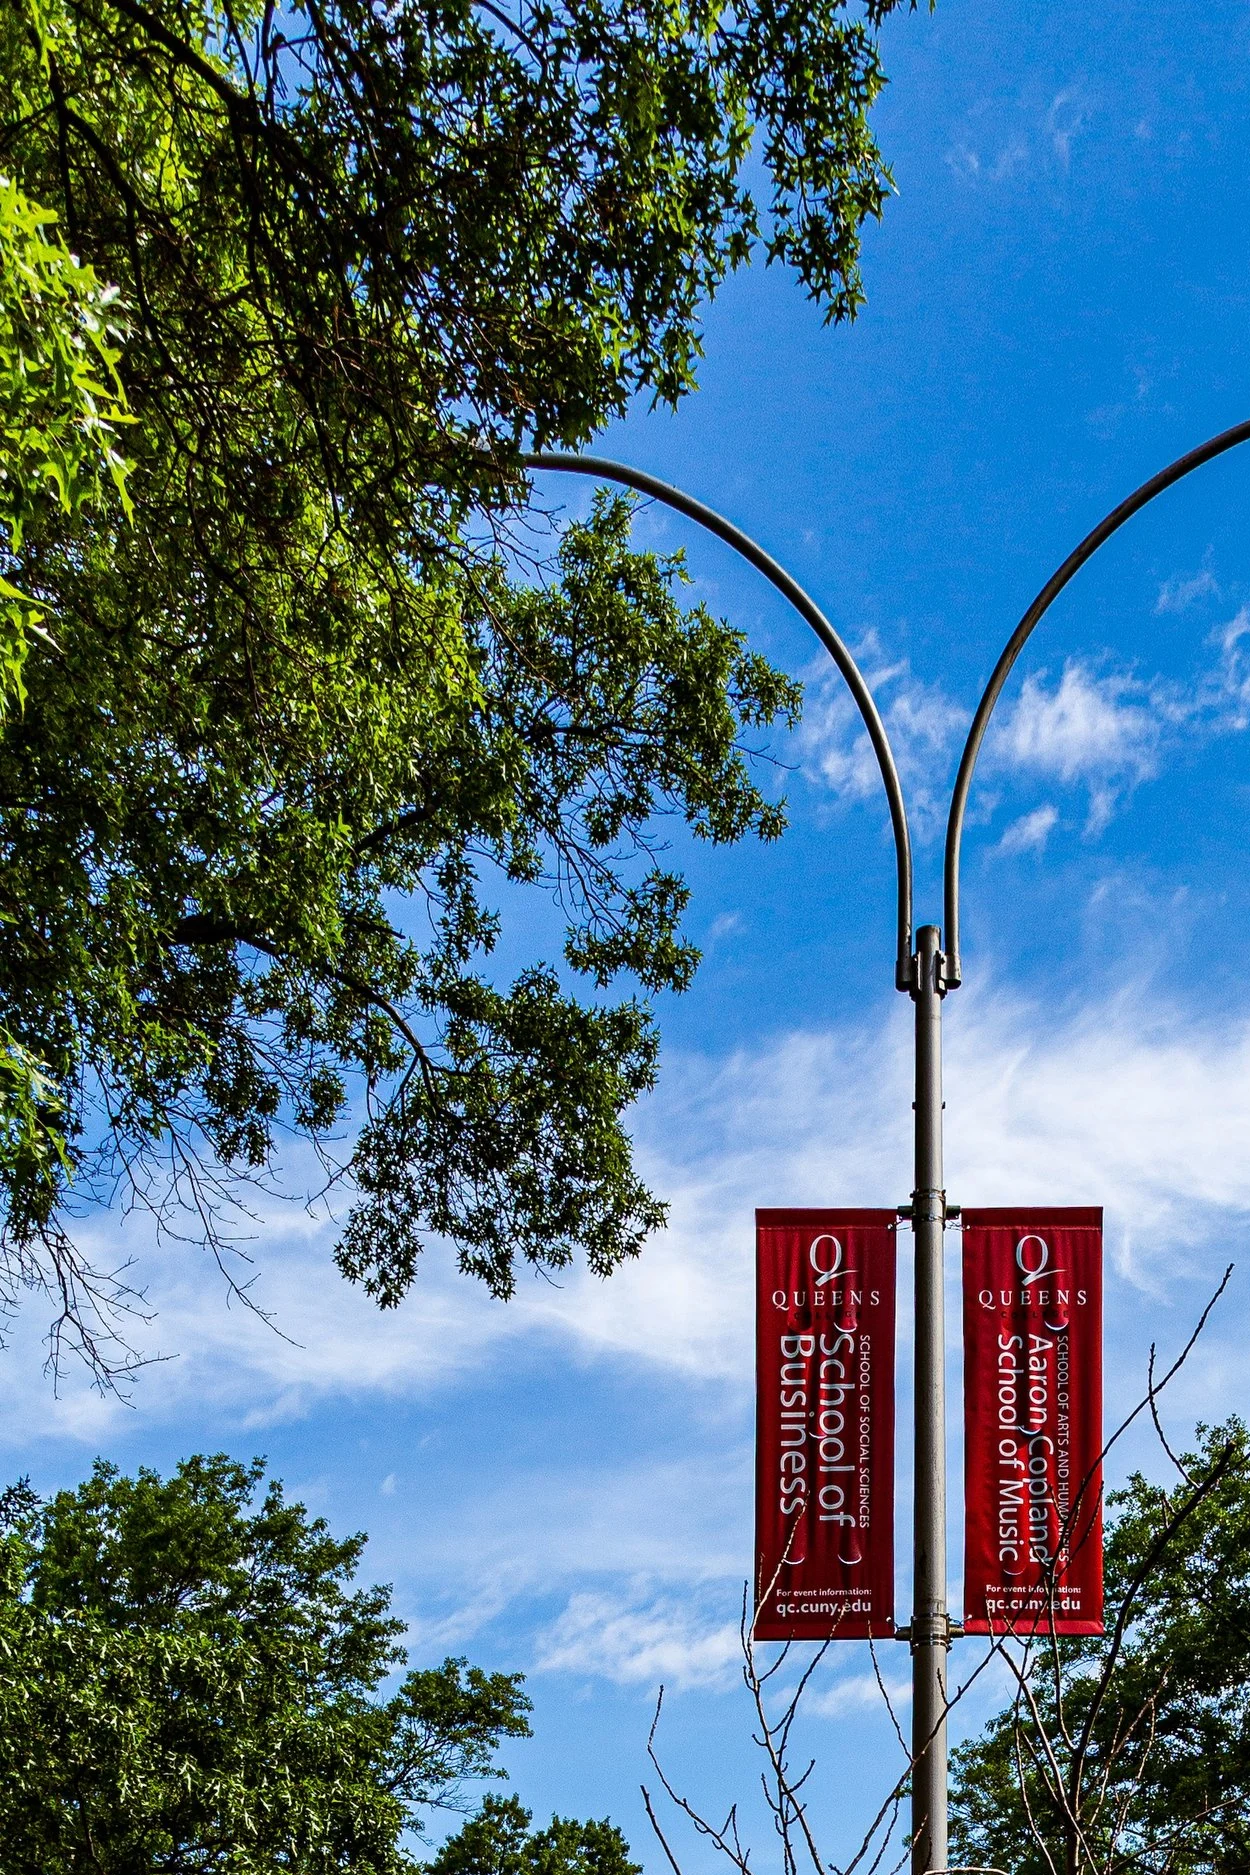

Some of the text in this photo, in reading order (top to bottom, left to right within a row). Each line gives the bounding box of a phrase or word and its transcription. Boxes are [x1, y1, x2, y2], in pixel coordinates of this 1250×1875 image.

[809, 1234, 859, 1287] Q
[1015, 1234, 1067, 1287] Q
[772, 1290, 880, 1311] QUEENS
[978, 1289, 1088, 1310] QUEENS
[1057, 1335, 1069, 1389] SCHOOL
[1057, 1394, 1069, 1410] OF
[780, 1335, 815, 1515] Business
[819, 1333, 856, 1528] School of
[859, 1334, 870, 1529] SCHOOL OF SOCIAL SCIENCES
[1058, 1413, 1069, 1446] ARTS
[998, 1334, 1025, 1562] School of Music
[1023, 1334, 1054, 1563] Aaron Copland
[1058, 1450, 1069, 1478] AND
[776, 1587, 872, 1597] For event information:
[776, 1599, 872, 1617] qc.cuny.edu
[986, 1584, 1081, 1594] For event infoation:
